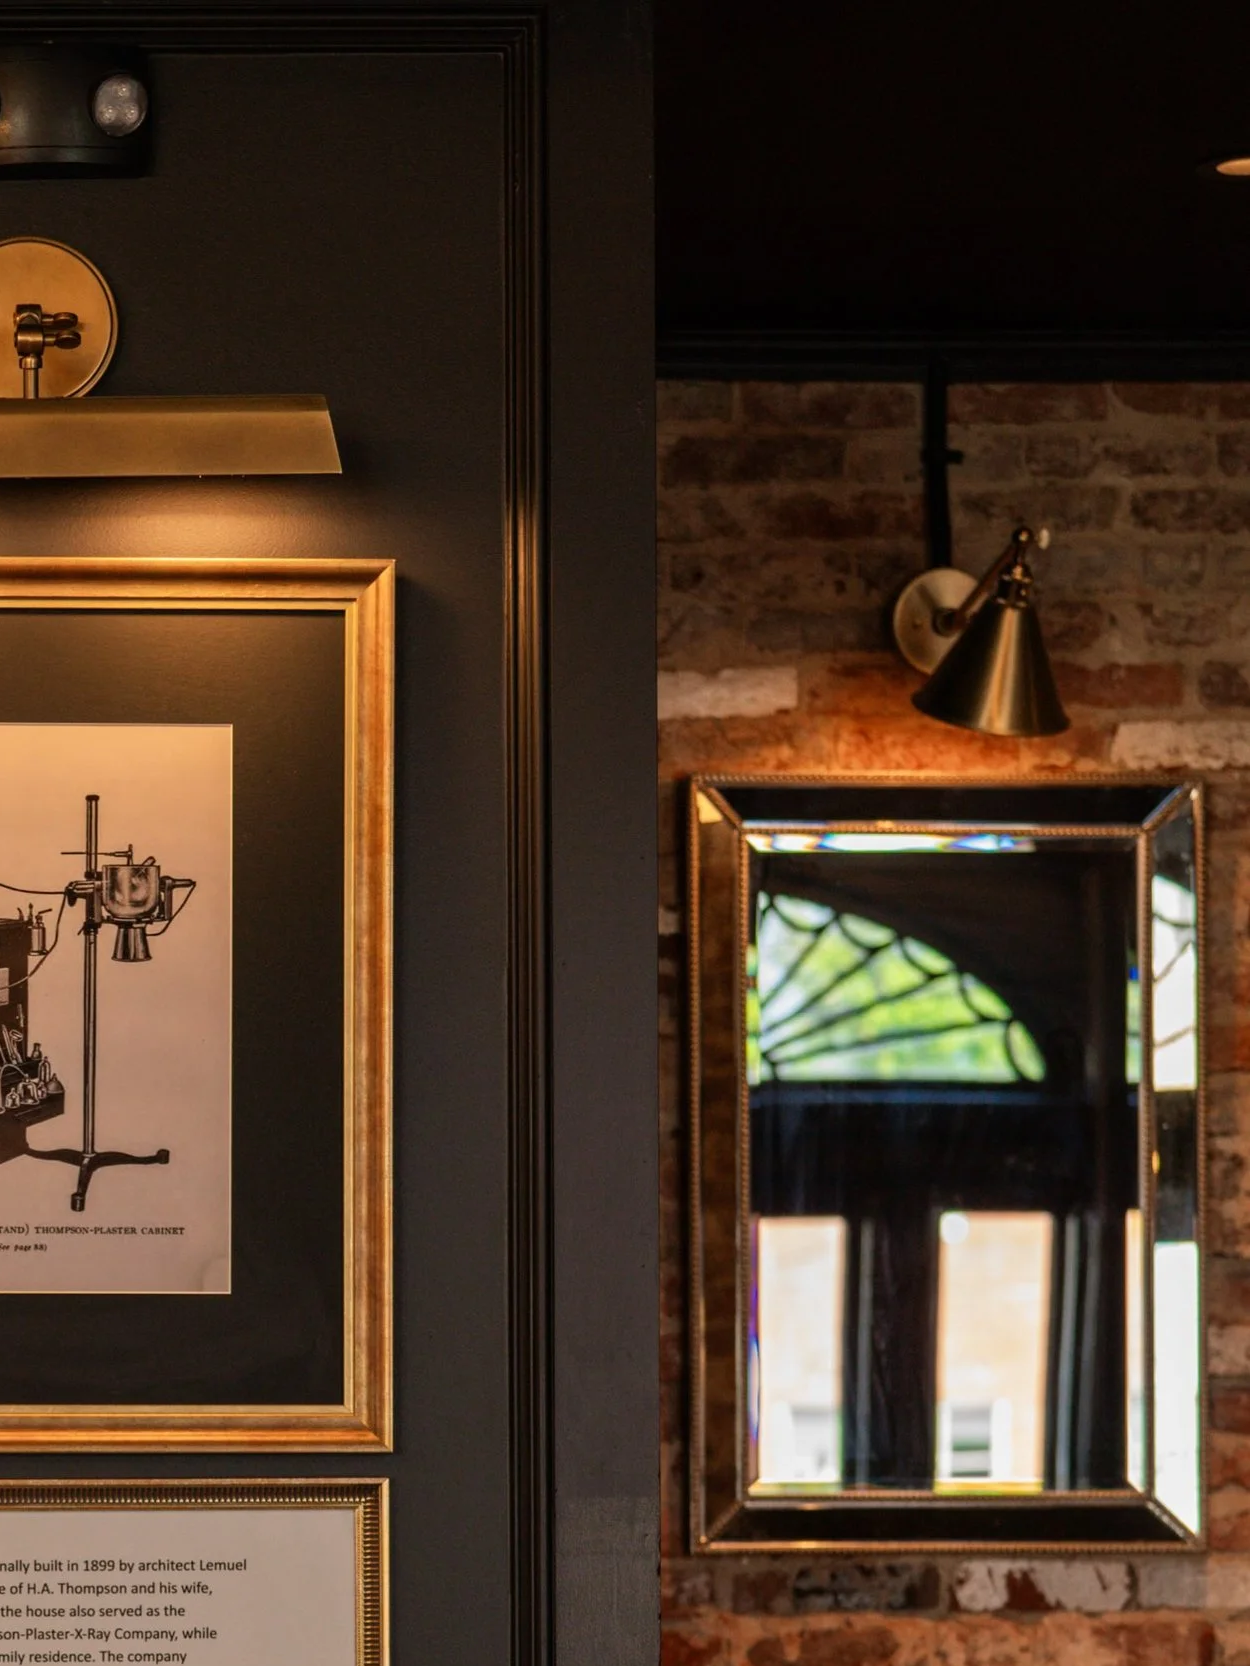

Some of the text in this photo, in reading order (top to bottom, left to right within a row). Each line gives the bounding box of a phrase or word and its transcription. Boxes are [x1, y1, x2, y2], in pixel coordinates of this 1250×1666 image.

[34, 1225, 138, 1236] THOMPSON-PLASTER
[140, 1226, 186, 1236] CABINET
[13, 1243, 32, 1252] page
[33, 1559, 64, 1573] built
[66, 1559, 79, 1572] in
[83, 1559, 116, 1572] 1899
[118, 1558, 136, 1575] by
[137, 1558, 196, 1572] architect
[199, 1558, 247, 1572] Lemuel
[9, 1581, 24, 1596] of
[26, 1582, 55, 1595] H.A.
[56, 1581, 128, 1598] Thompson
[130, 1581, 156, 1595] and
[158, 1580, 178, 1595] his
[180, 1580, 213, 1596] wife,
[0, 1604, 23, 1618] the
[25, 1604, 66, 1618] house
[68, 1604, 96, 1618] also
[98, 1604, 143, 1618] served
[145, 1607, 161, 1618] as
[163, 1603, 186, 1617] the
[113, 1627, 179, 1643] Company,
[181, 1626, 218, 1640] while
[28, 1649, 96, 1664] residence.
[98, 1649, 125, 1663] The
[126, 1652, 188, 1666] company
